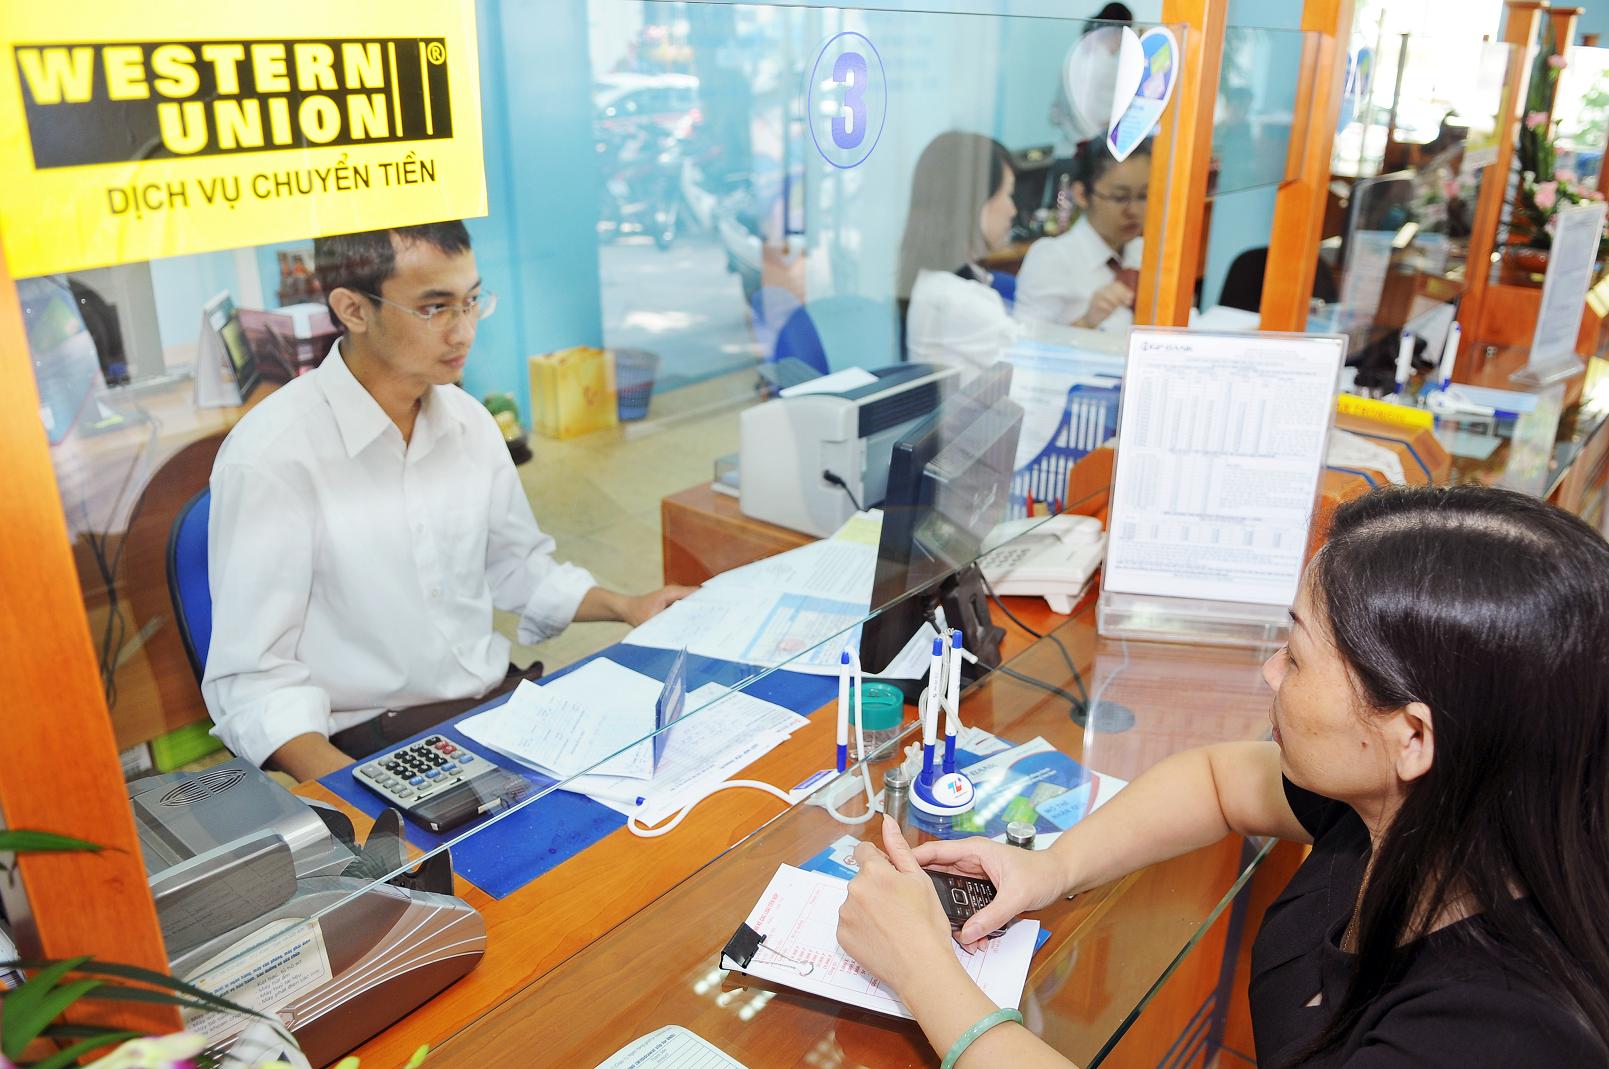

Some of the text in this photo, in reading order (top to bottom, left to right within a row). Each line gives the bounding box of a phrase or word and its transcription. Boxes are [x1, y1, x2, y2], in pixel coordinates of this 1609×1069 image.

[16, 42, 386, 105] WESTERN
[831, 51, 868, 149] 3
[158, 94, 391, 154] UNION
[107, 151, 436, 219] DỊCH VỤ CHUYỂN TIỀN
